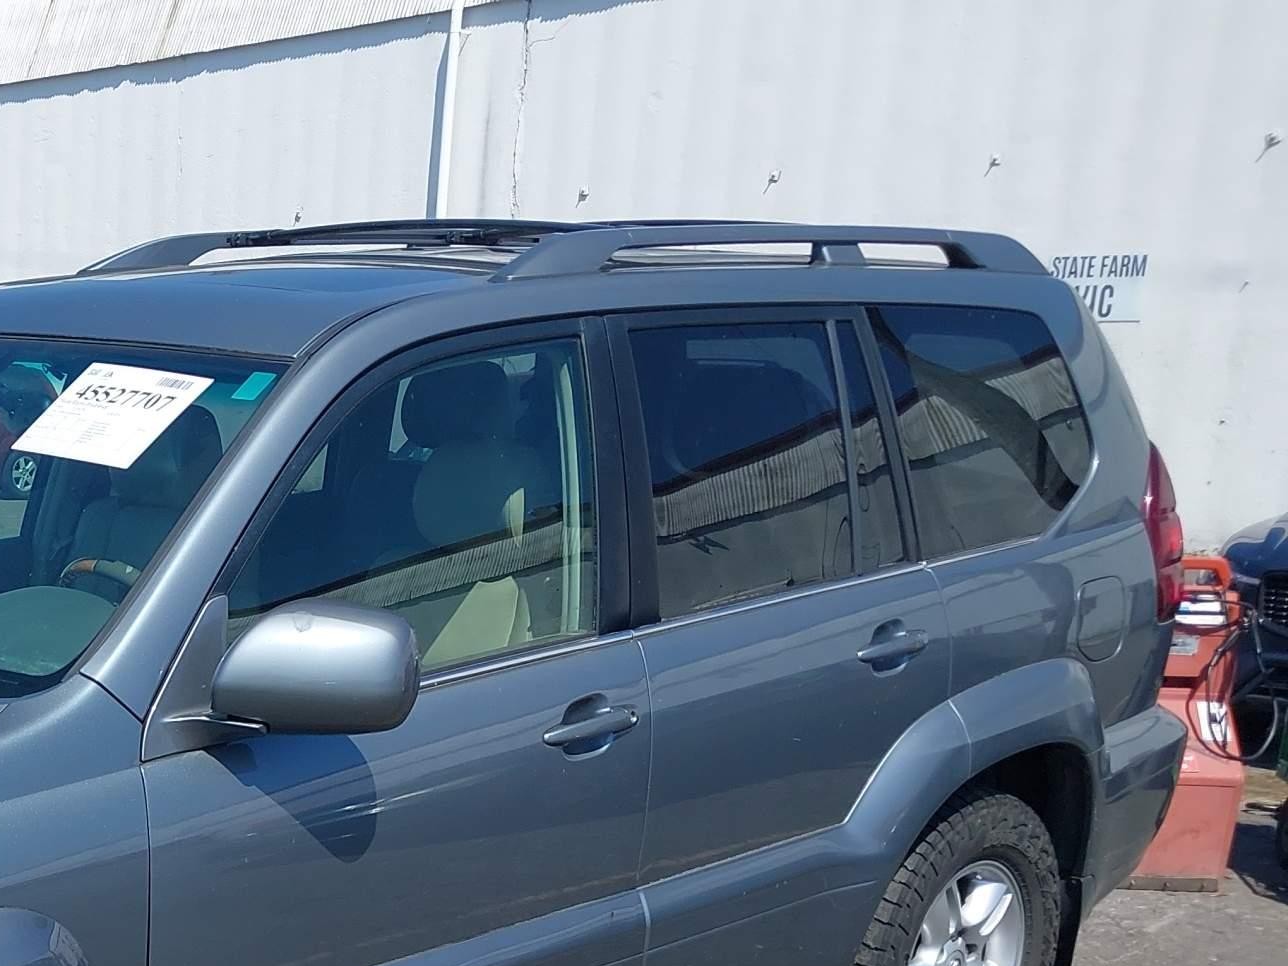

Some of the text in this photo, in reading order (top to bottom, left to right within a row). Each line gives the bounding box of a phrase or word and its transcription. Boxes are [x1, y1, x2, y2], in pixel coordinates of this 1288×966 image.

[1050, 254, 1149, 279] STATE FARM
[76, 383, 177, 412] 45527707
